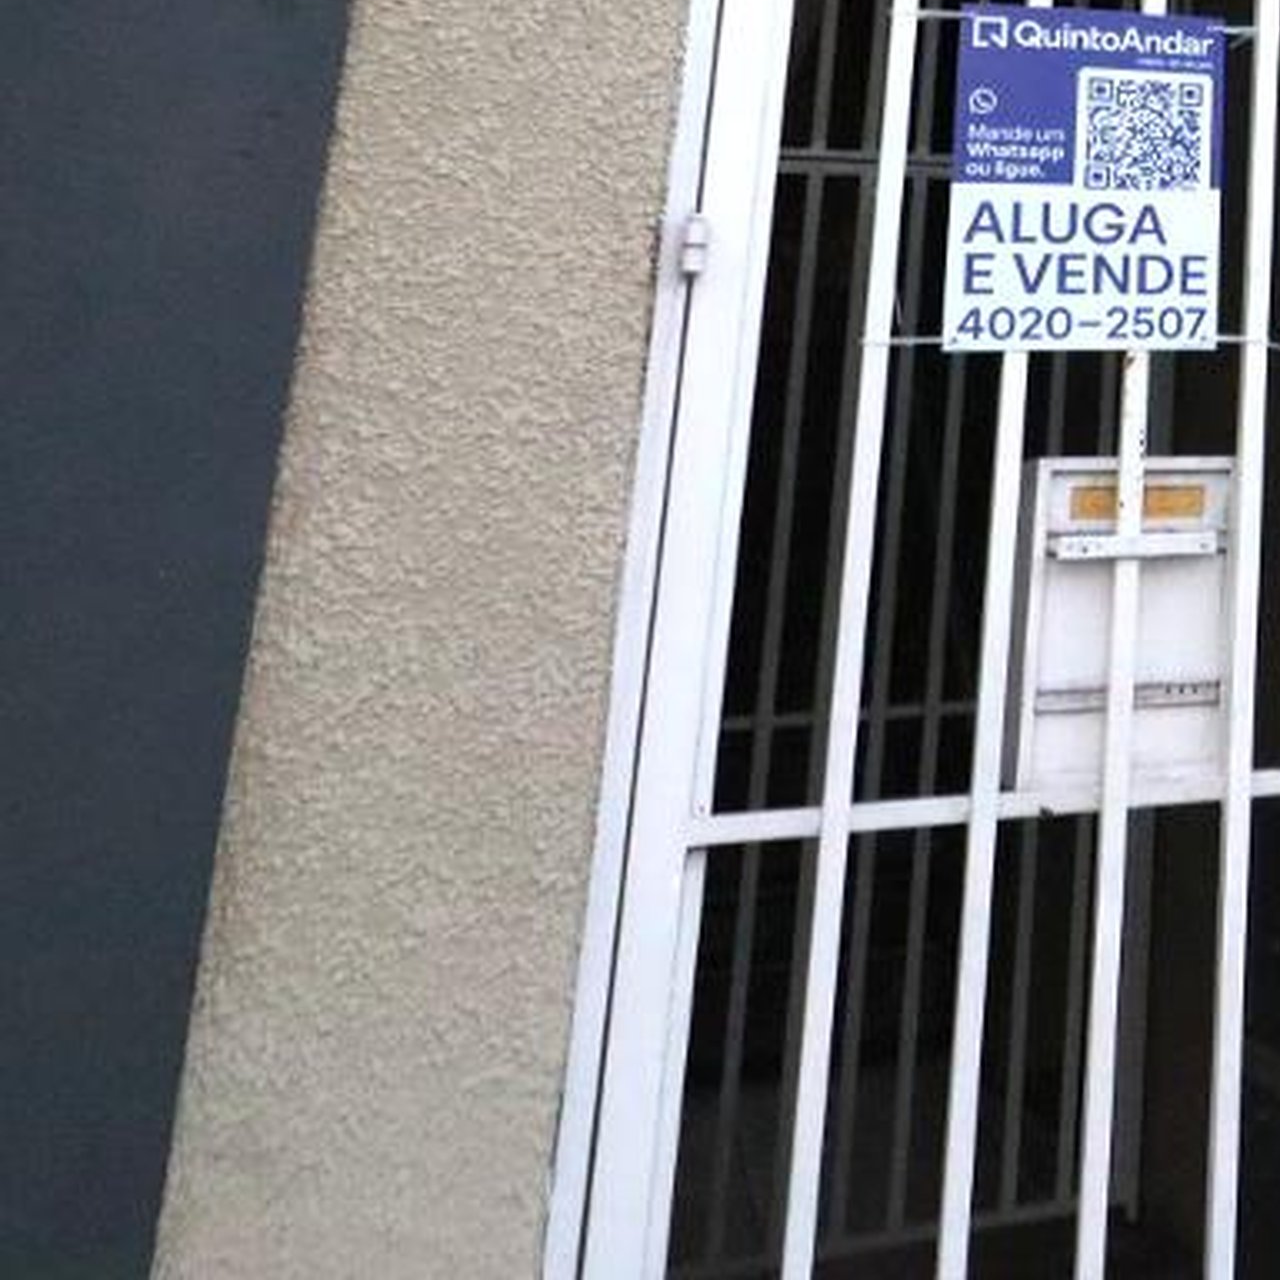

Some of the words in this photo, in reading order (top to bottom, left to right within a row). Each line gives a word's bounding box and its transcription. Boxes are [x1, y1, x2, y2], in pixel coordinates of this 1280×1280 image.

[1013, 19, 1214, 56] QuintoAndar
[968, 123, 1033, 142] Mande
[1036, 128, 1065, 142] um
[965, 162, 991, 177] ou
[966, 142, 1065, 164] Whatsapp
[963, 200, 1168, 245] ALUGA
[963, 253, 995, 295] E
[1013, 253, 1208, 296] VENDE
[956, 306, 1208, 342] 4020-2507
